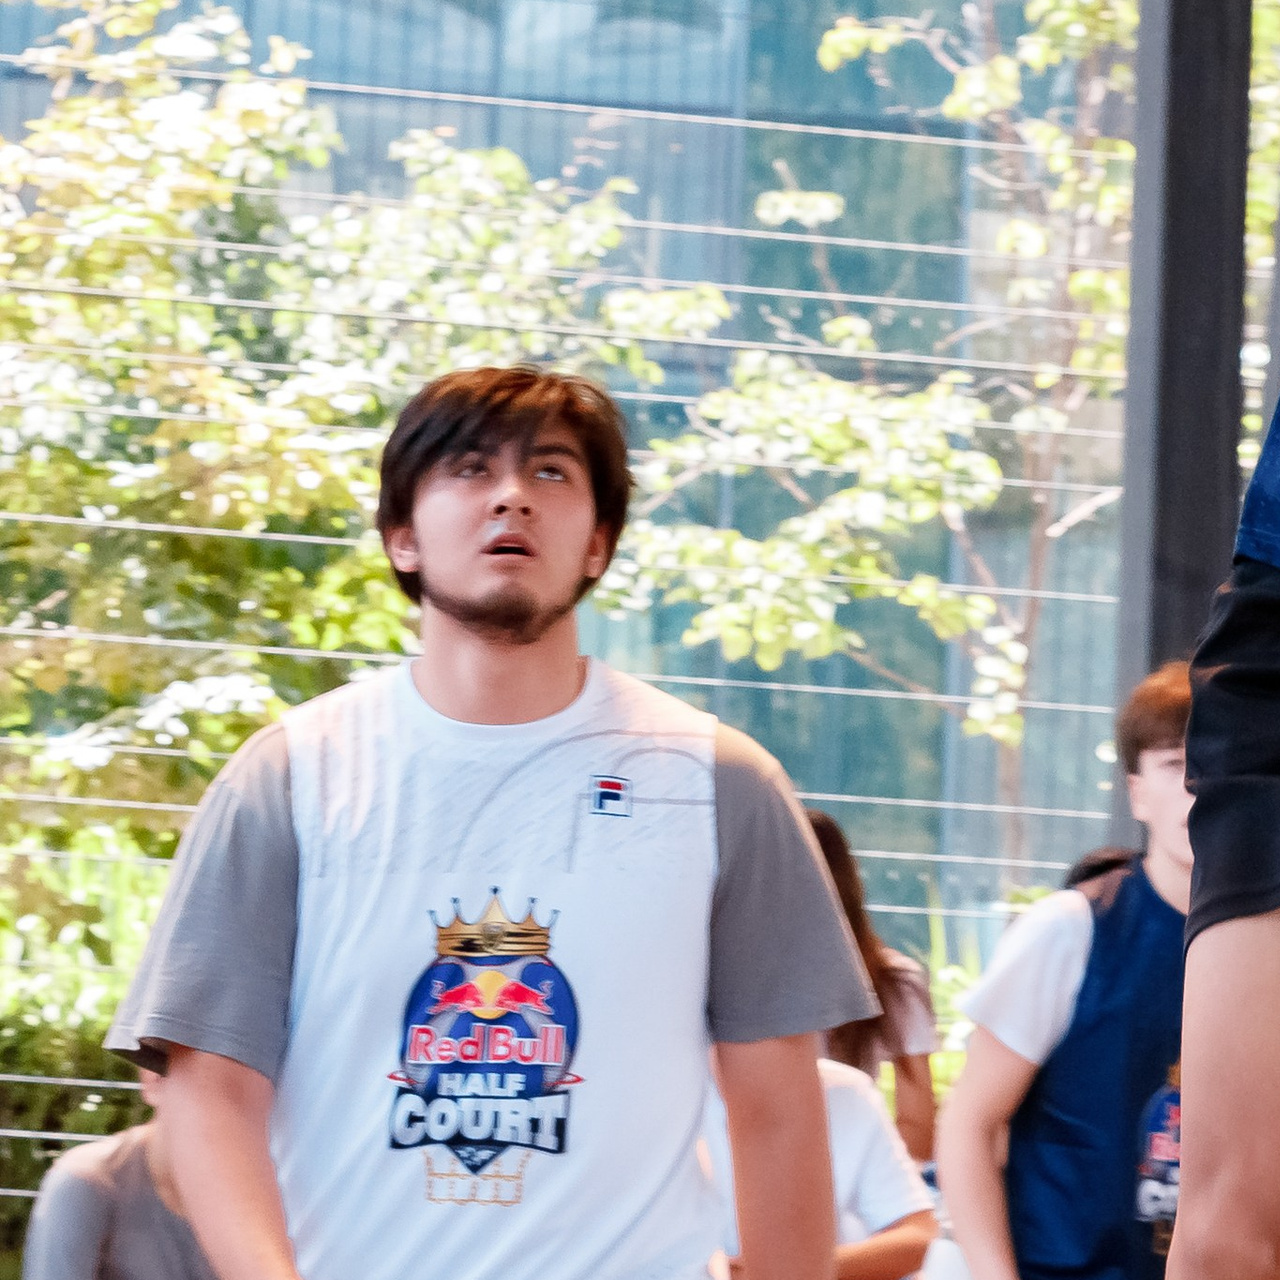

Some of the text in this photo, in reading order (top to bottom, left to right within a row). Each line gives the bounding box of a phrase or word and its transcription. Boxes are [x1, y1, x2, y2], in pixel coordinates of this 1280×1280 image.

[408, 1023, 566, 1066] Red Bull
[437, 1072, 526, 1097] HALF
[393, 1093, 566, 1148] COURT
